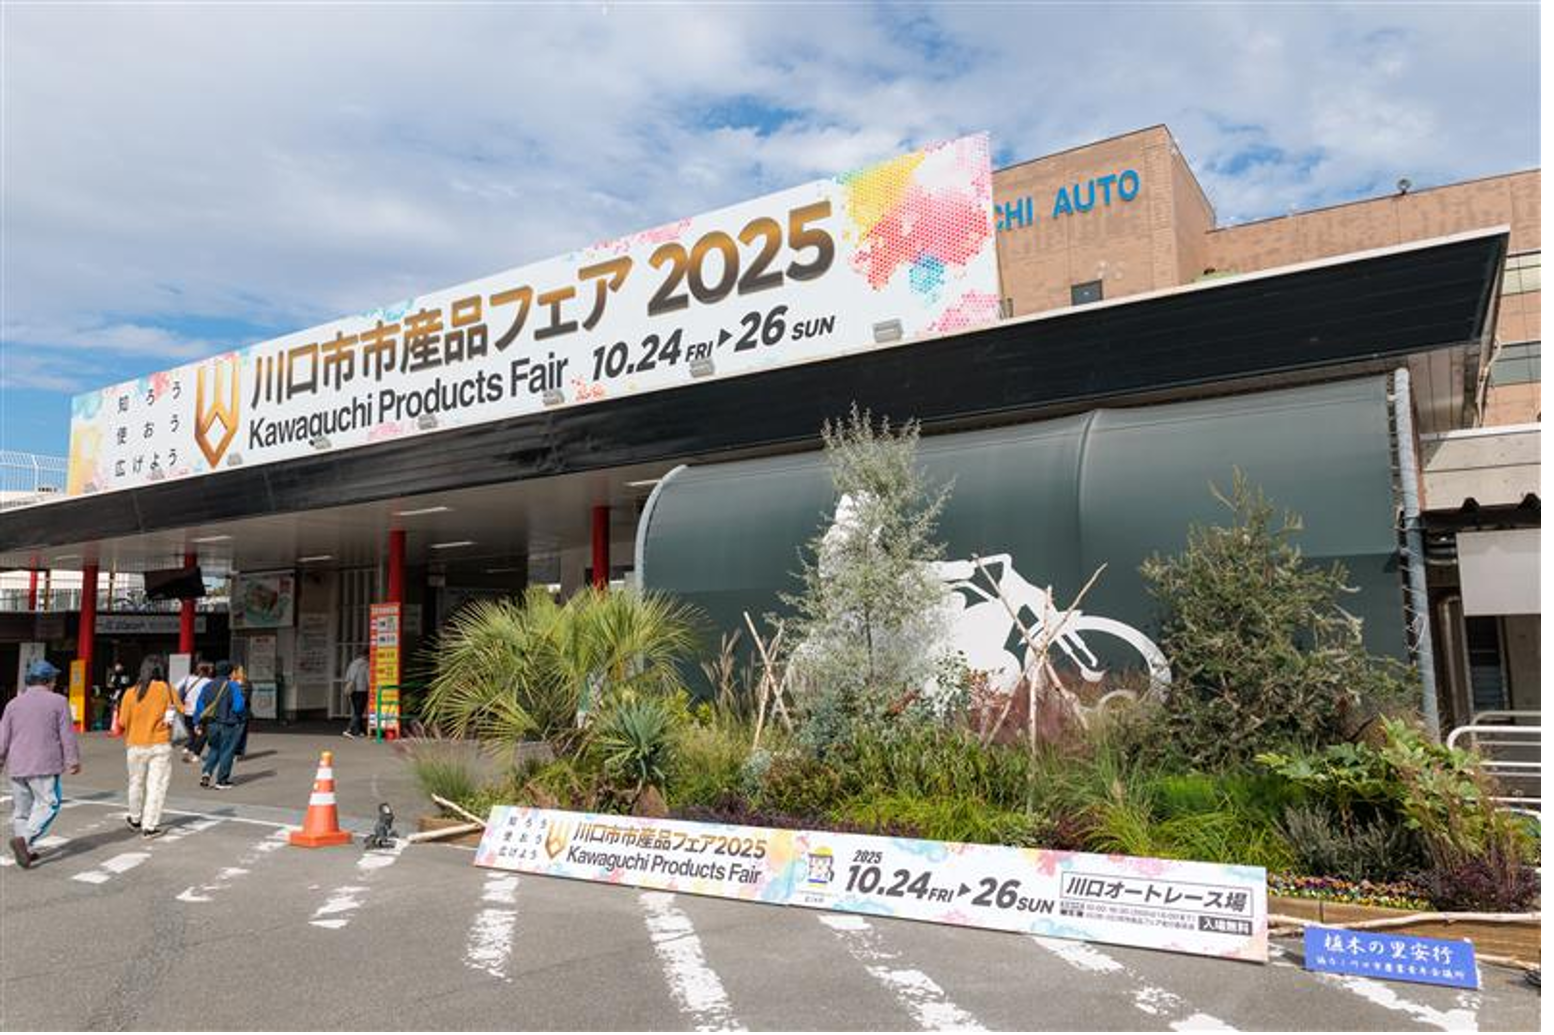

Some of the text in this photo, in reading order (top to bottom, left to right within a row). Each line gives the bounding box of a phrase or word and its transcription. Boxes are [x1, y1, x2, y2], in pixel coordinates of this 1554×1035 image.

[1053, 169, 1140, 219] AUTO
[251, 200, 835, 409] 川口市市産品フェア 2025
[593, 305, 835, 381] 10.24 FRI 26 SUN
[249, 352, 568, 449] Kawaguchi Products Fair
[566, 845, 763, 884] Kawaguchi Products Fair
[853, 849, 882, 864] 2025
[845, 864, 1054, 914] 10.24 FRI 26 SUN
[1066, 877, 1248, 912] 川口オートレース場
[1323, 933, 1454, 965] 植木の里安行
